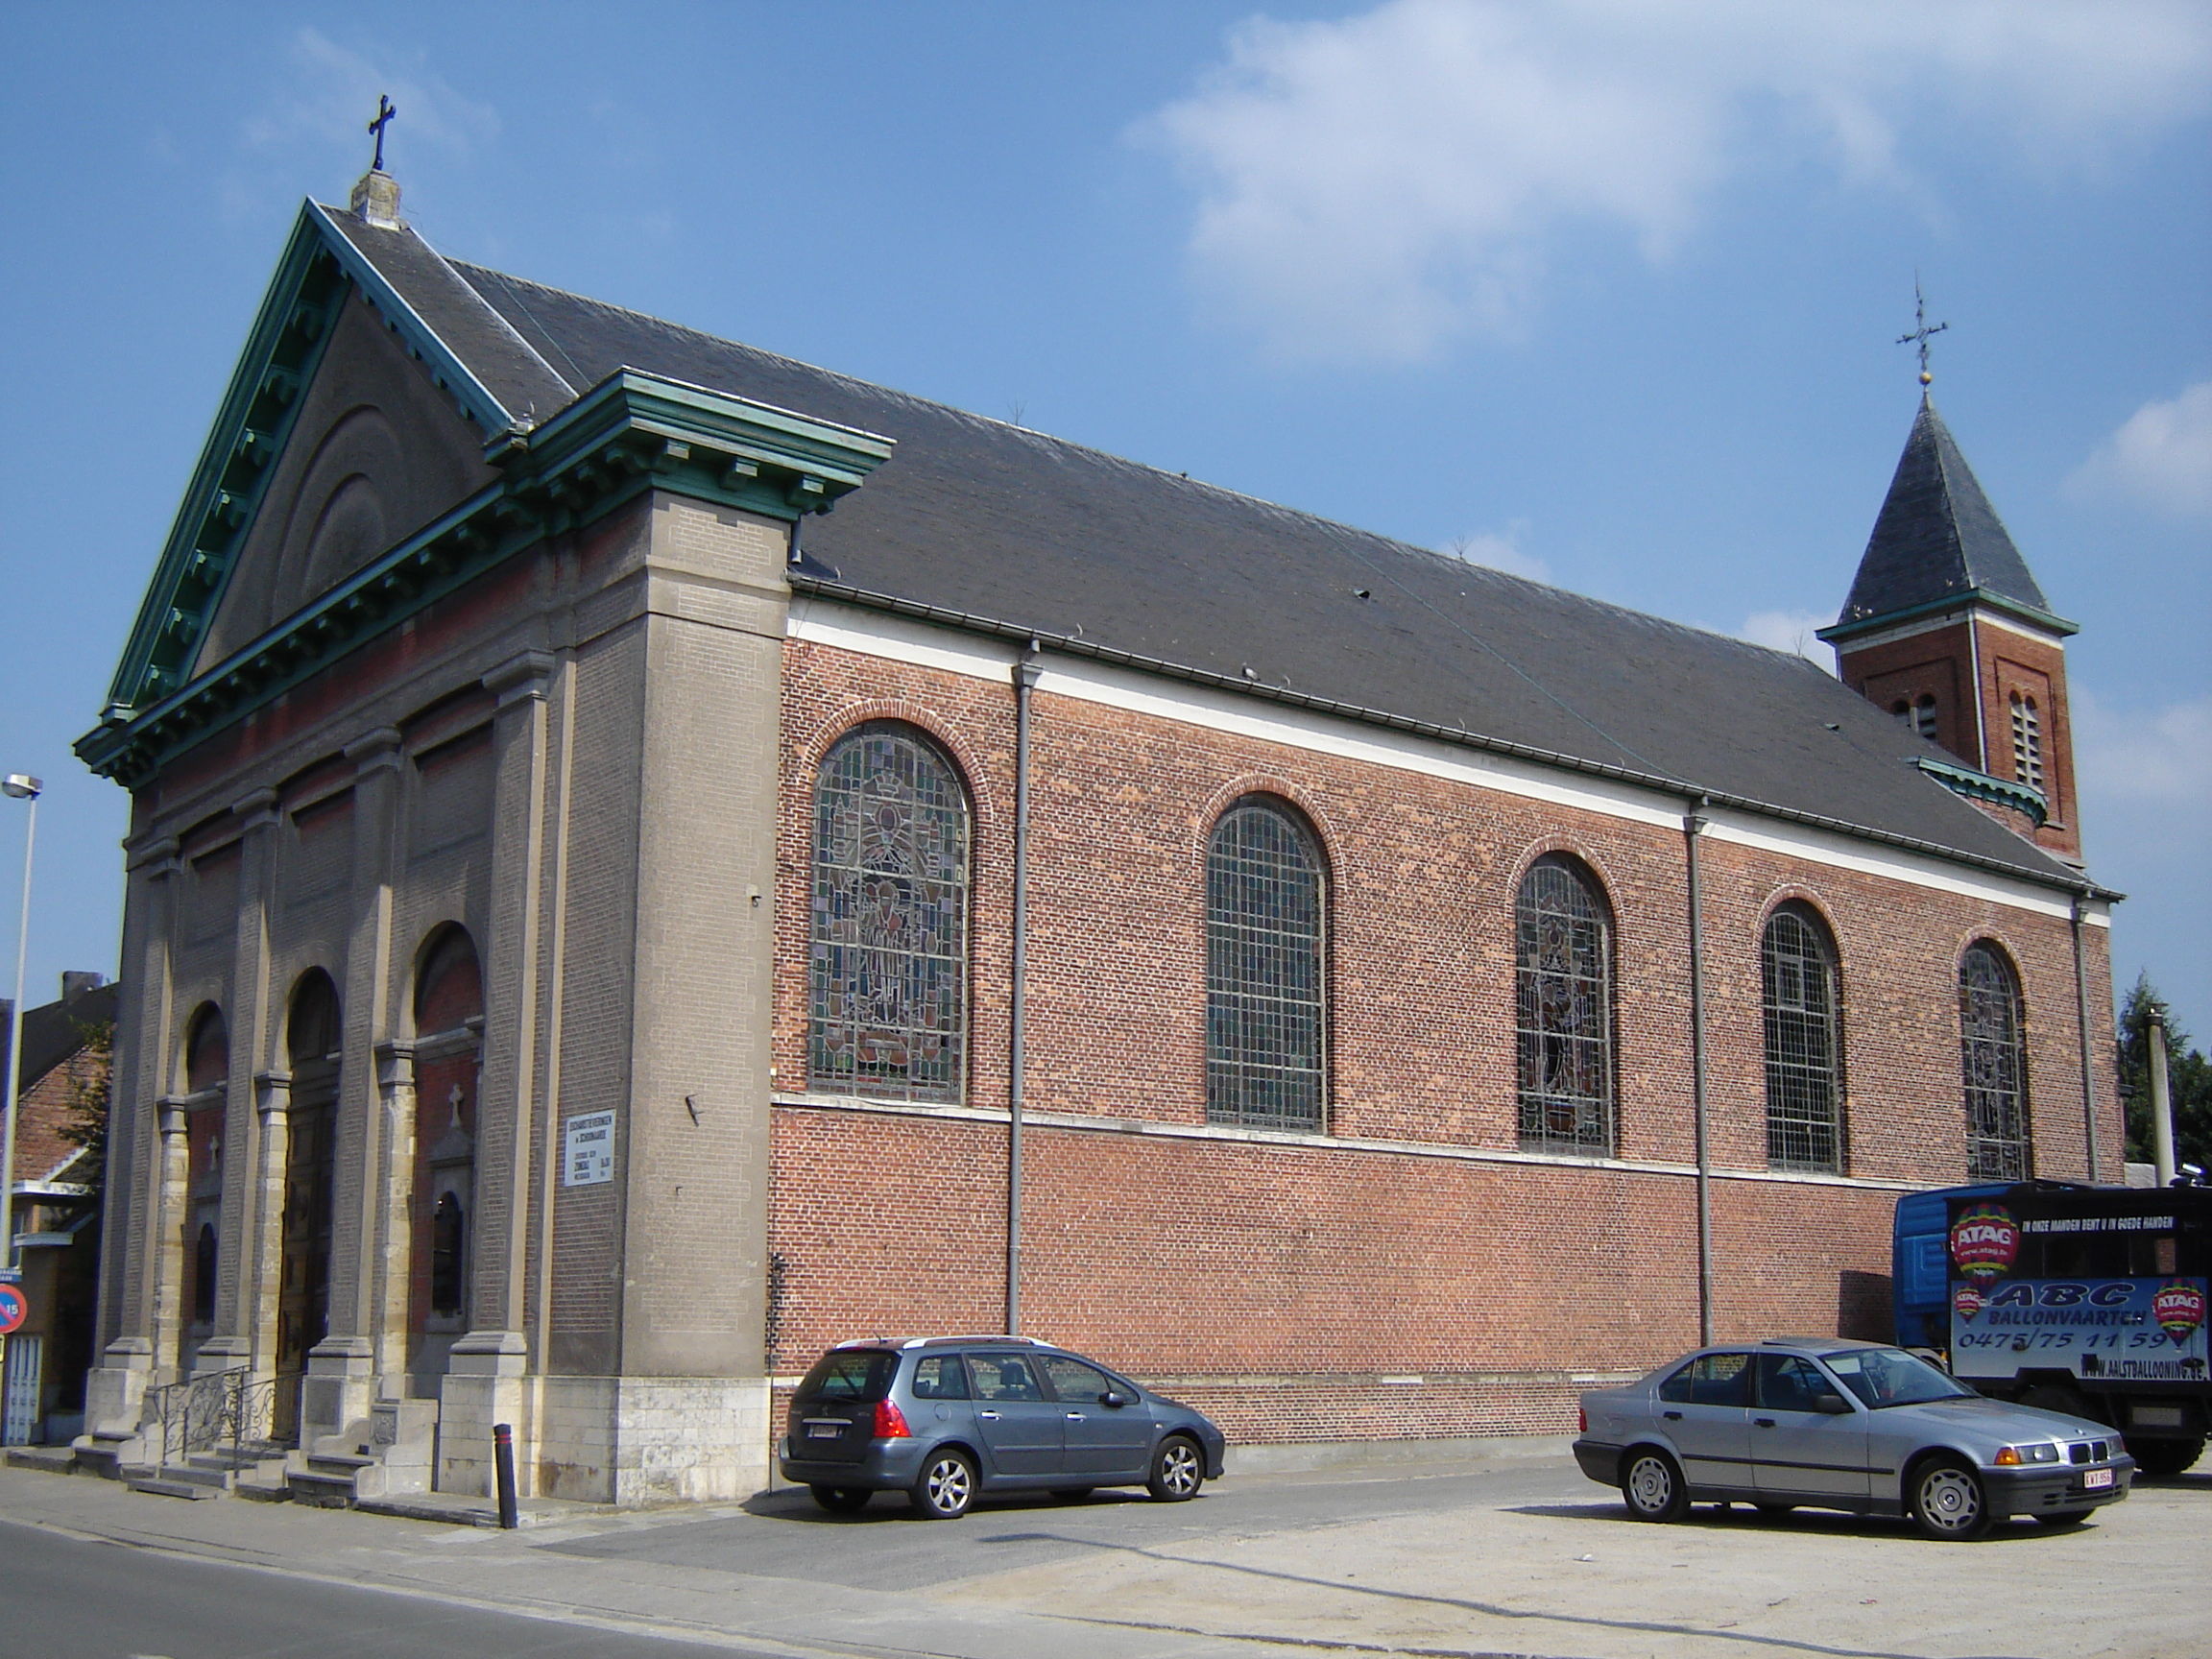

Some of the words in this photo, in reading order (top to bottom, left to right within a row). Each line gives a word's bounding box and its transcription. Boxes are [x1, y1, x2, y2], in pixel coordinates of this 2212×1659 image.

[2051, 1218, 2081, 1232] MANDEN
[2081, 1218, 2101, 1231] BENT
[2117, 1216, 2142, 1230] GOEDE
[2143, 1215, 2175, 1230] HANDEN
[1959, 1225, 2011, 1246] ATAG
[1988, 1283, 2136, 1307] ABC
[2157, 1294, 2200, 1309] ATAG
[7, 1304, 19, 1315] 15
[1988, 1310, 2147, 1326] BALLONVAARTEN
[1959, 1327, 2074, 1350] 0475/75
[2085, 1333, 2120, 1348] 11
[2128, 1333, 2168, 1349] 59
